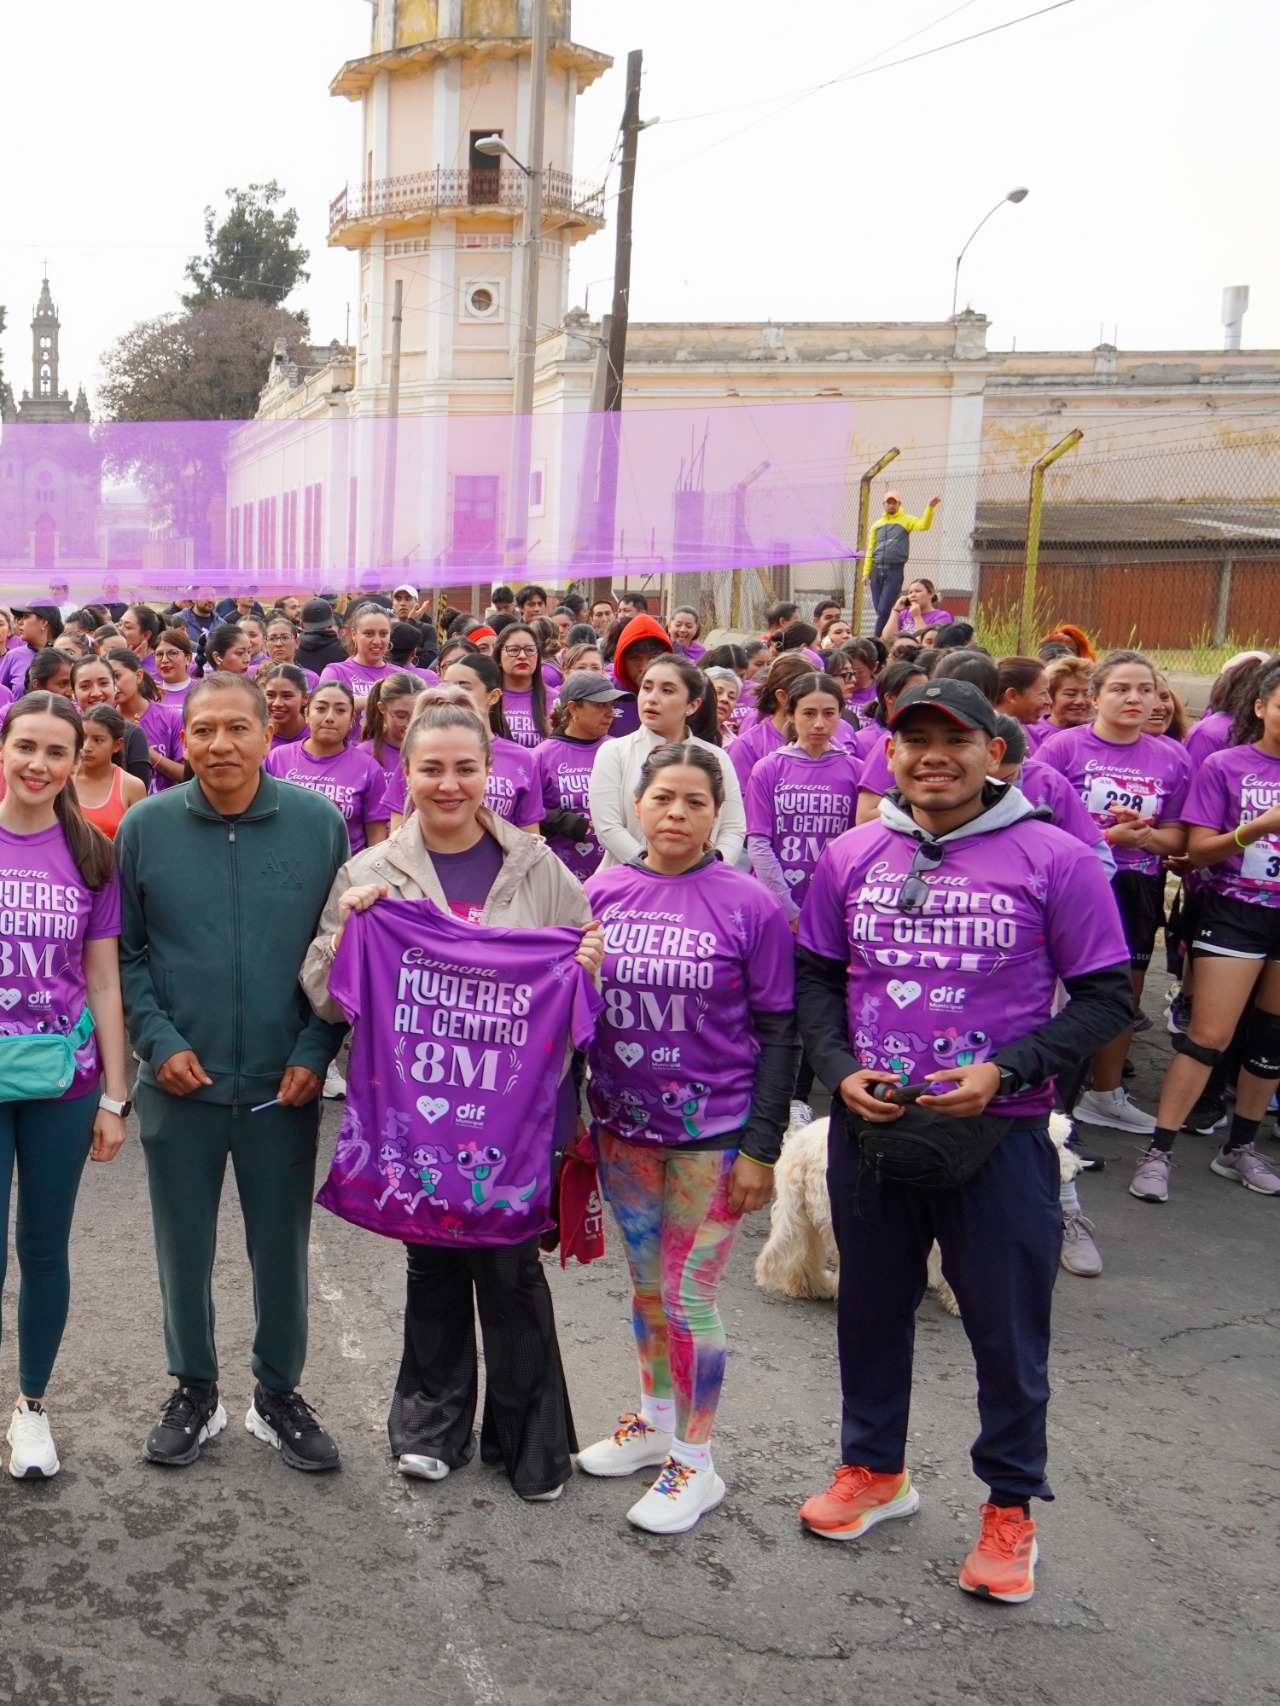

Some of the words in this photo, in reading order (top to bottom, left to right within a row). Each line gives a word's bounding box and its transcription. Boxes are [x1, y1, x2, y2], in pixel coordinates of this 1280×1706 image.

[1085, 759, 1142, 774] Carrera
[774, 778, 832, 793] Carrera
[1241, 773, 1280, 787] Carr
[560, 795, 578, 809] AL
[773, 793, 851, 816] MUJERES
[776, 817, 788, 835] AL
[792, 815, 849, 834] CENTRO
[865, 861, 971, 887] Carera
[602, 902, 684, 923] Carrera
[0, 910, 78, 940] CENTRO
[853, 913, 884, 942] AL
[893, 918, 1017, 948] CENTRO
[401, 947, 499, 979] Carrera
[616, 956, 714, 990] CENTRO
[28, 990, 52, 1005] dif
[396, 967, 533, 1017] MUJERES
[930, 986, 966, 1004] dif
[604, 988, 689, 1033] 8M
[394, 1004, 424, 1035] AL
[431, 1008, 529, 1047] CENTRO
[651, 1047, 680, 1062] dif
[410, 1041, 502, 1092] 8M
[456, 1103, 486, 1120] dif
